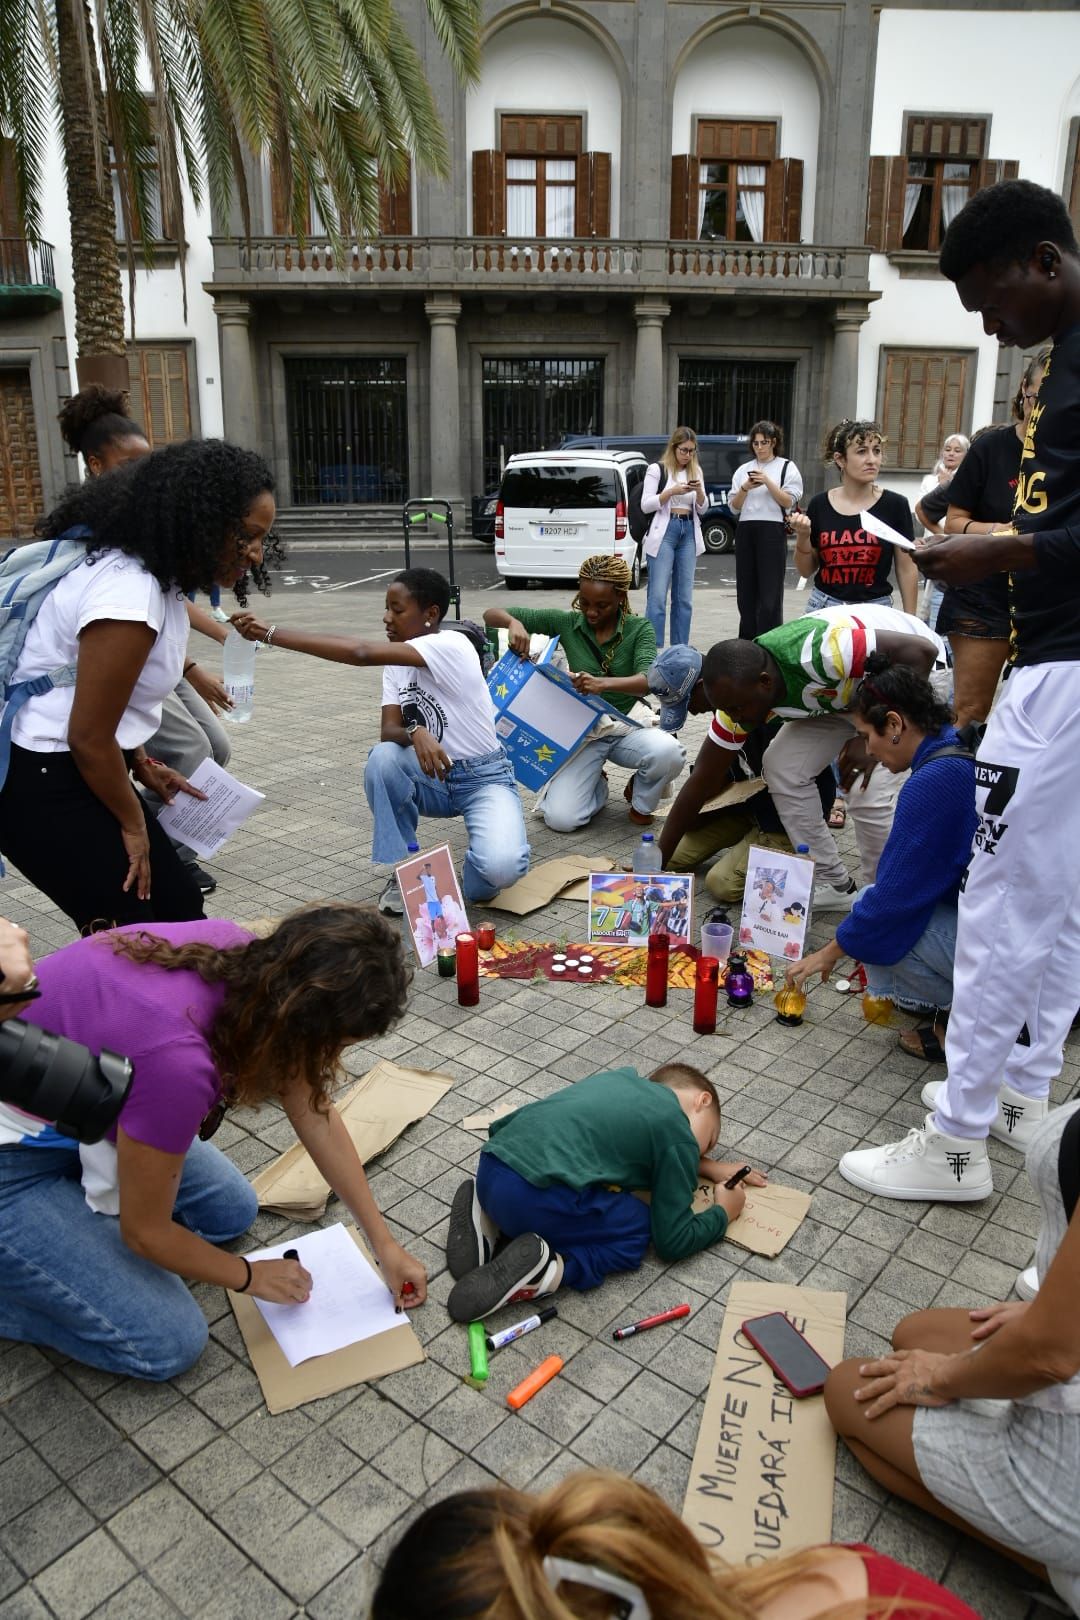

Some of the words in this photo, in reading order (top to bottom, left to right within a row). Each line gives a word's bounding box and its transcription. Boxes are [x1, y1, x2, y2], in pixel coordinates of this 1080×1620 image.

[544, 527, 562, 535] 9207
[819, 528, 879, 546] BLACK
[820, 567, 876, 585] MATTER
[594, 906, 625, 929] 77
[696, 1393, 748, 1502] MUERTE
[698, 1521, 725, 1549] U
